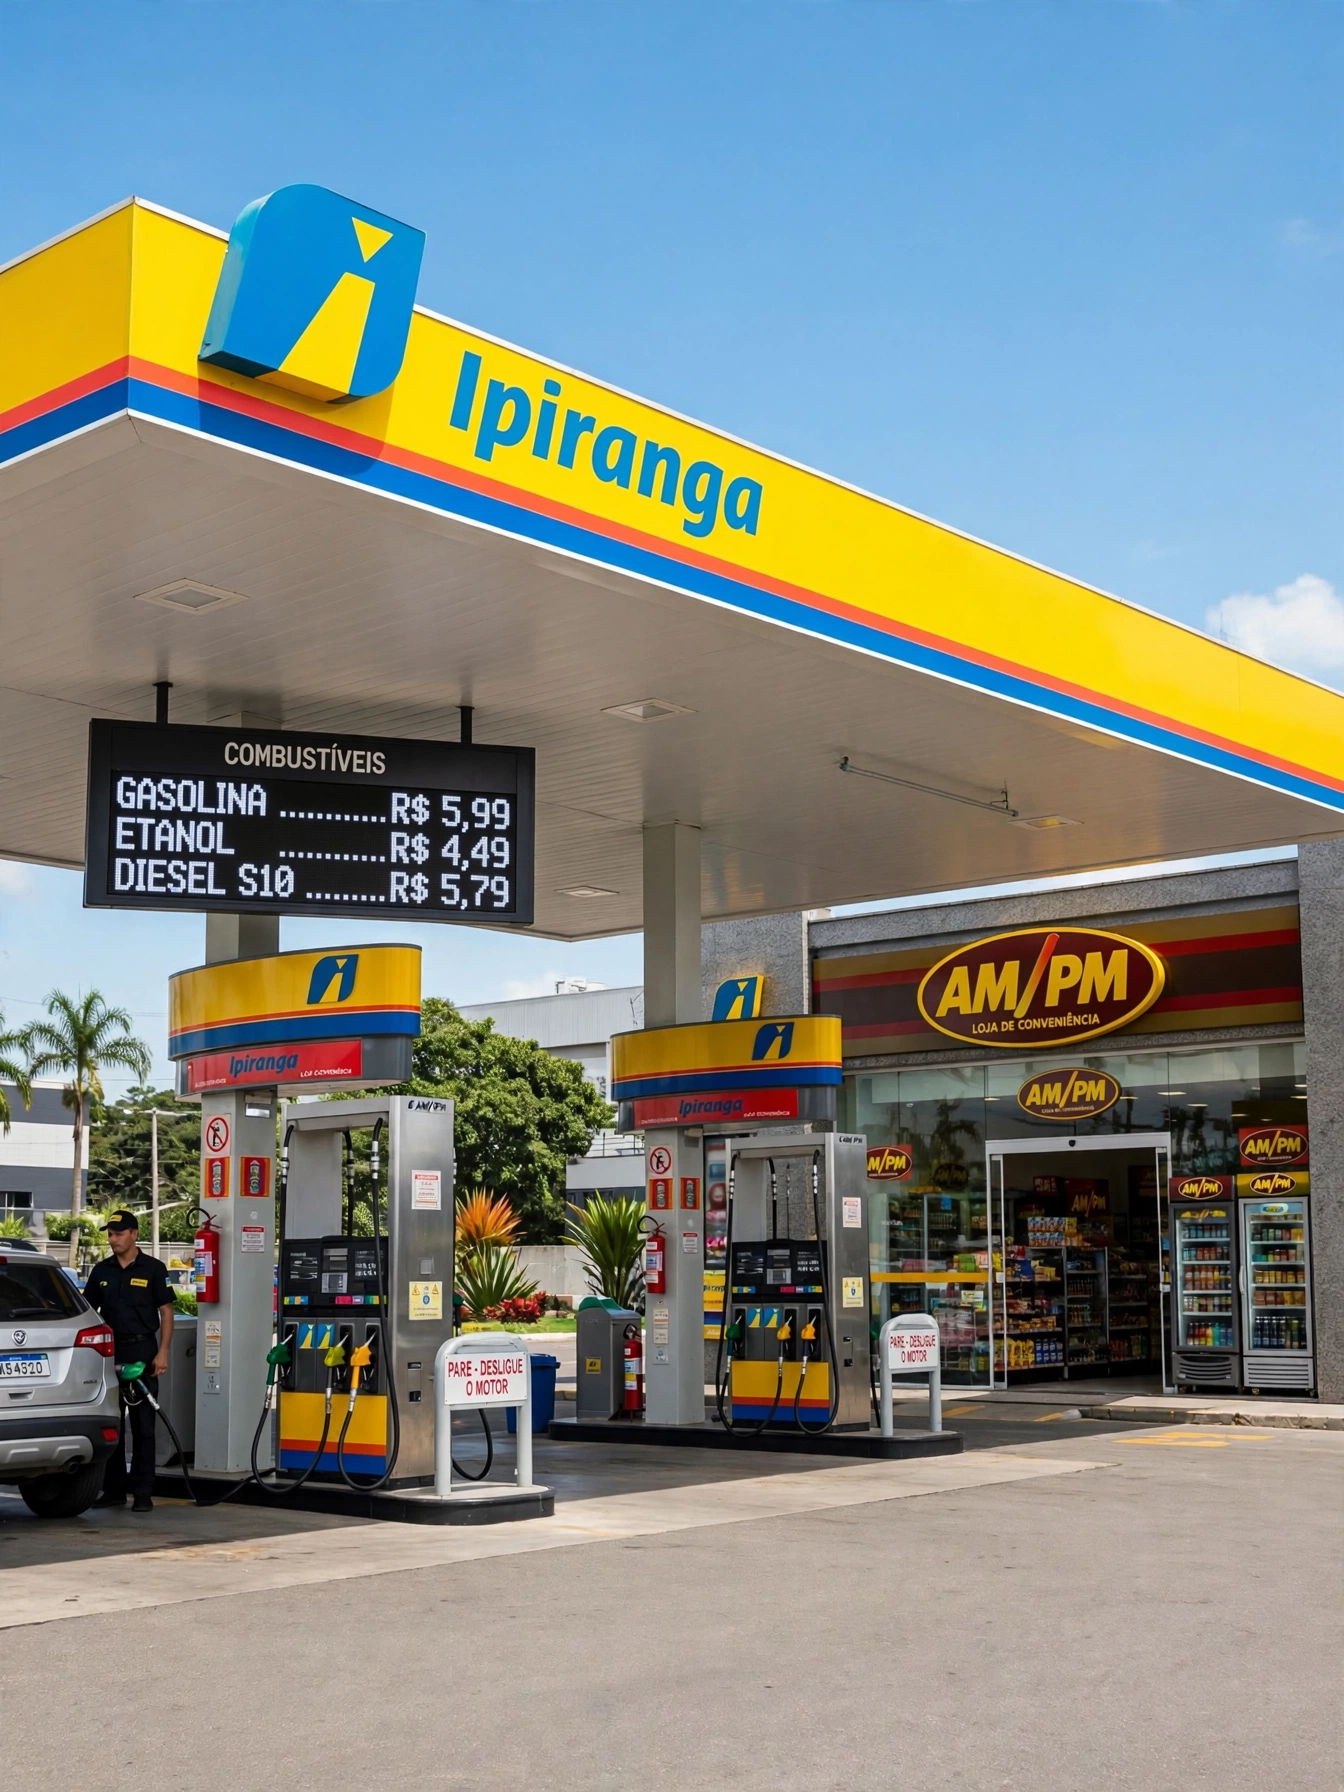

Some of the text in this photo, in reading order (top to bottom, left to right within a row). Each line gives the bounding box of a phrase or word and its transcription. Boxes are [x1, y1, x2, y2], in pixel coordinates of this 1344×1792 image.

[449, 350, 763, 538] Ipiranga
[224, 742, 386, 774] COMBUSTÍVEIS
[117, 776, 510, 833] GASOLINA R$ 5,99
[116, 816, 510, 871] ETANOL R$ 4,49
[114, 858, 510, 910] DIESEL S10 R$ 5,79
[935, 933, 1128, 1019] AM/PM
[972, 1012, 1100, 1034] LOJA DE CONVENIÊNCIA
[229, 1053, 299, 1078] Ipiranga
[1025, 1070, 1106, 1108] AM/PM
[679, 1098, 743, 1118] Ipiranga
[1245, 1130, 1301, 1157] AM/PM
[867, 1148, 906, 1176] M/PM
[1182, 1178, 1219, 1198] AM/PM
[1253, 1173, 1291, 1194] AM/PM
[448, 1360, 472, 1377] PARE
[480, 1358, 523, 1376] DESLIGUE
[901, 1350, 905, 1363] O
[466, 1378, 508, 1396] O MOTOR
